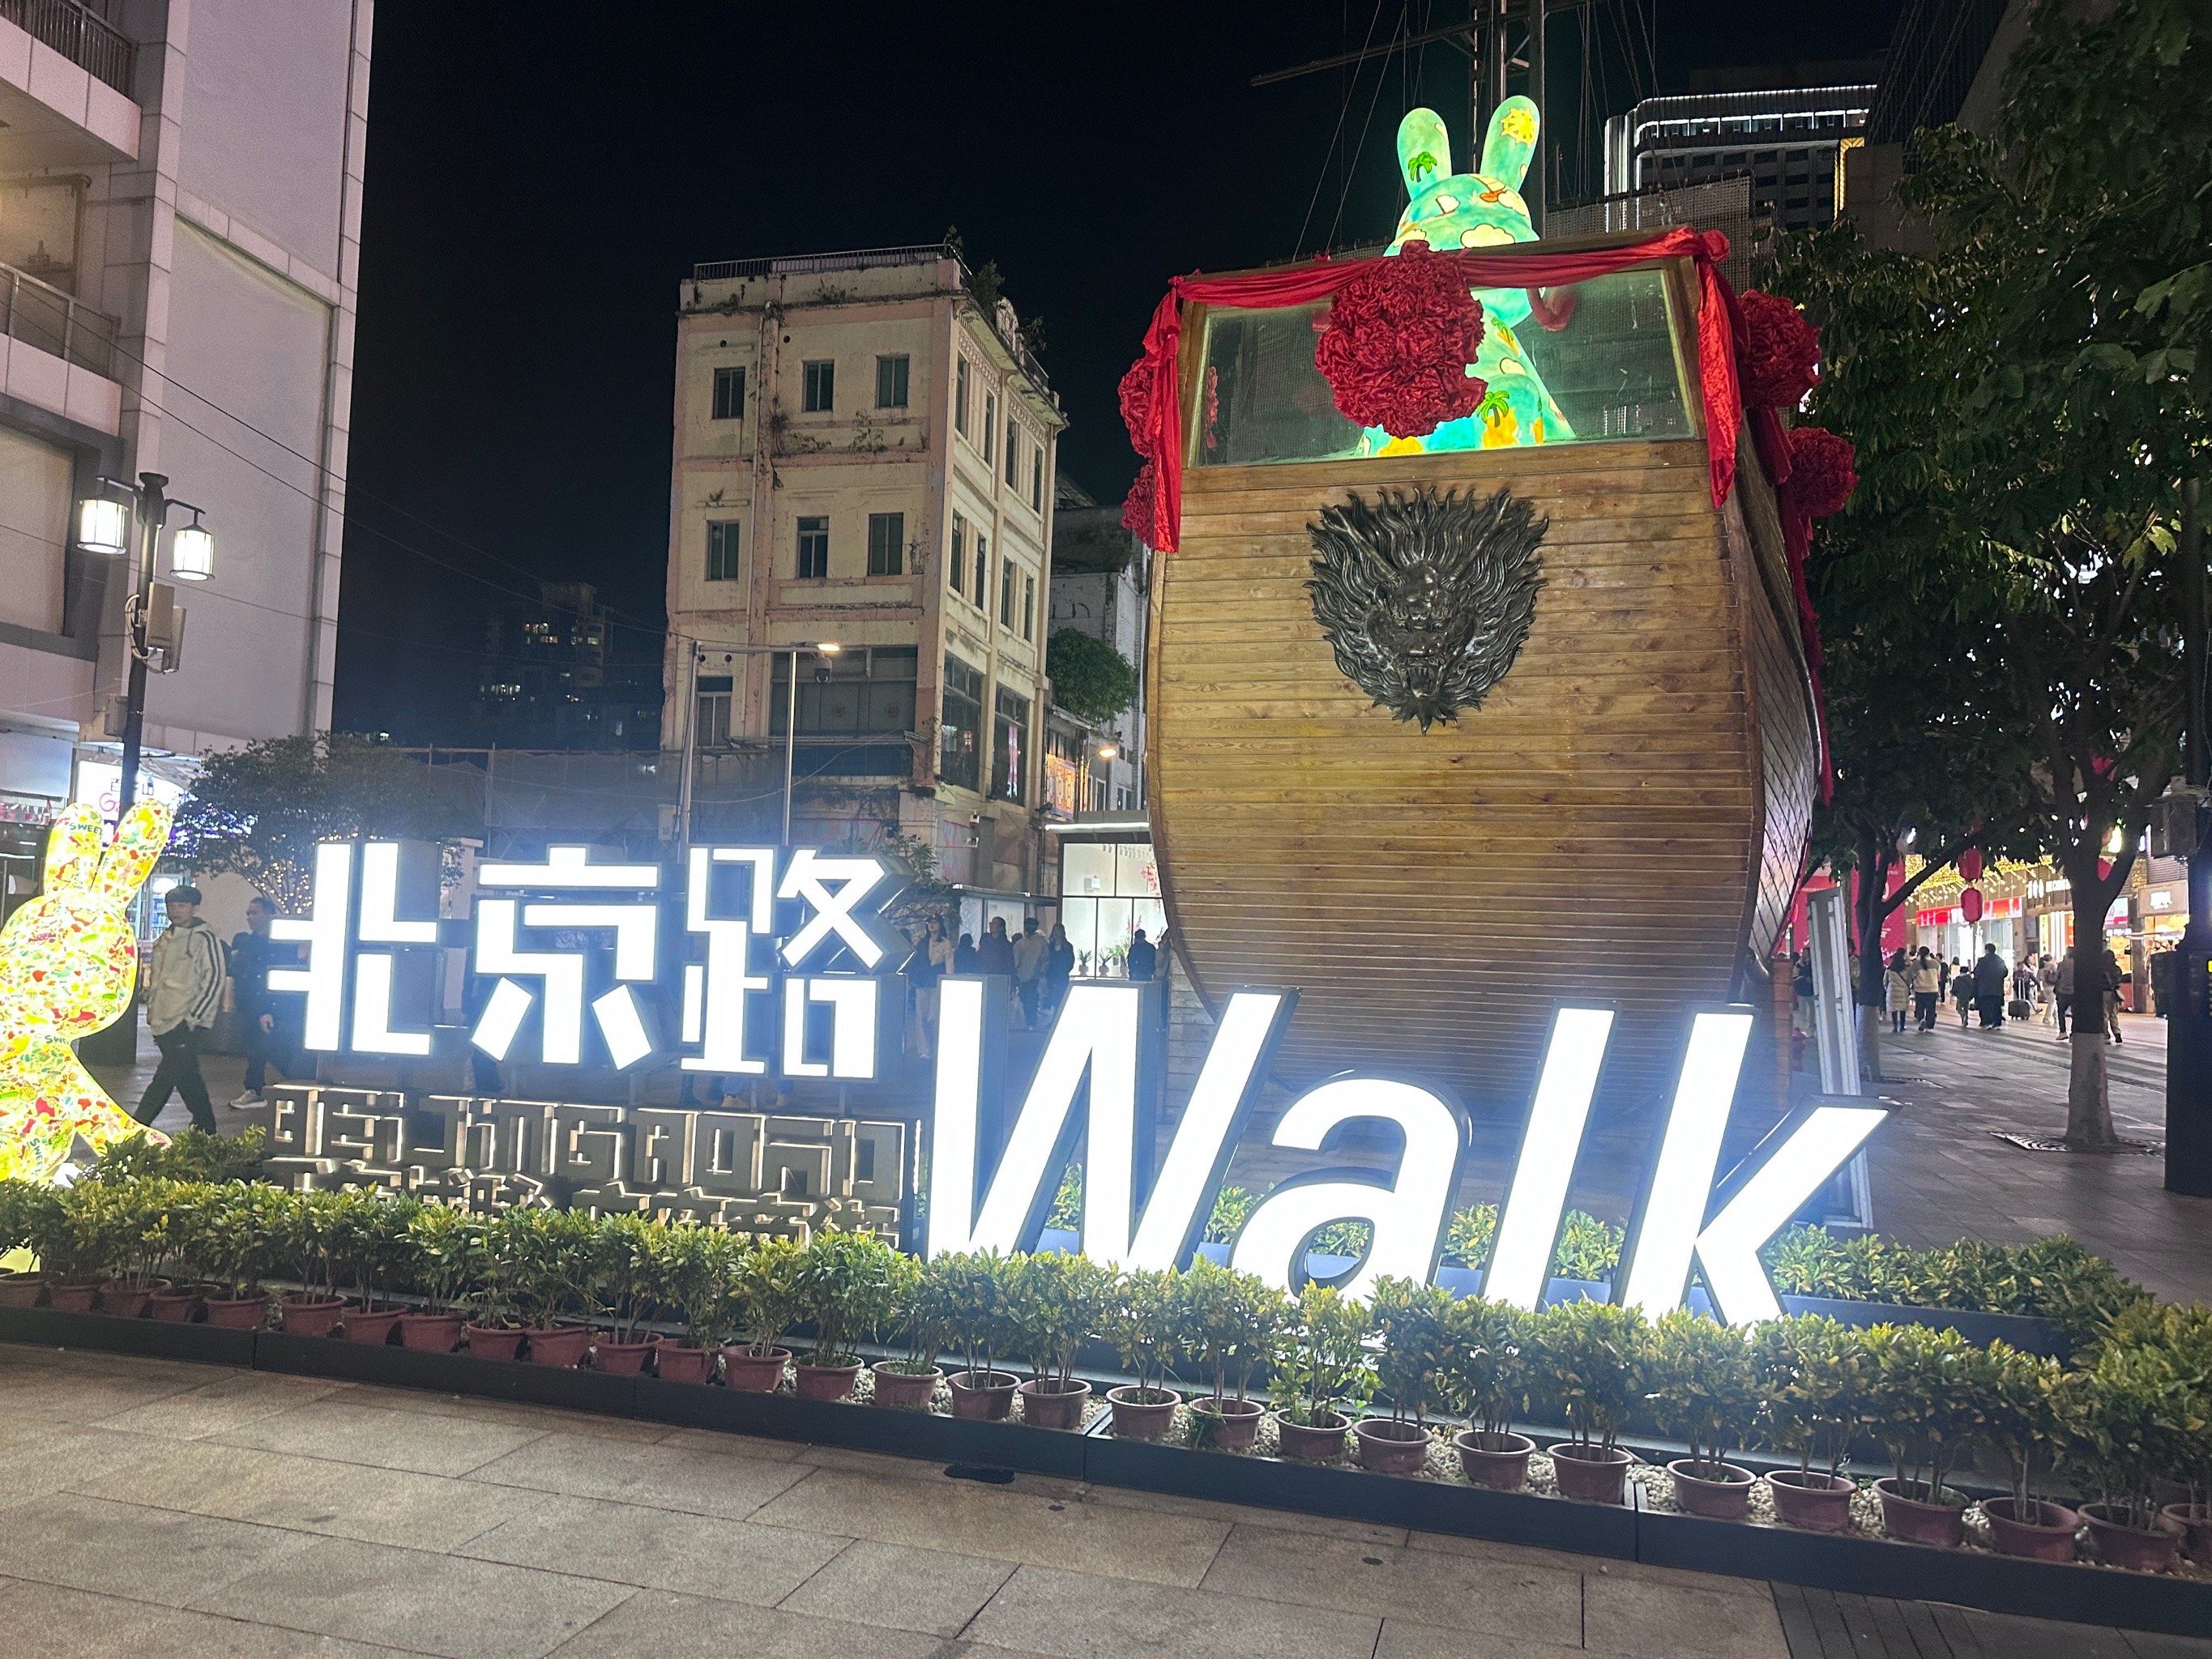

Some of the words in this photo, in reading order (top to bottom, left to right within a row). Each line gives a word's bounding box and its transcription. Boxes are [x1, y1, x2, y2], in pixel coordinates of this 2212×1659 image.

[267, 842, 886, 1078] 北京路
[927, 978, 1888, 1328] Walk
